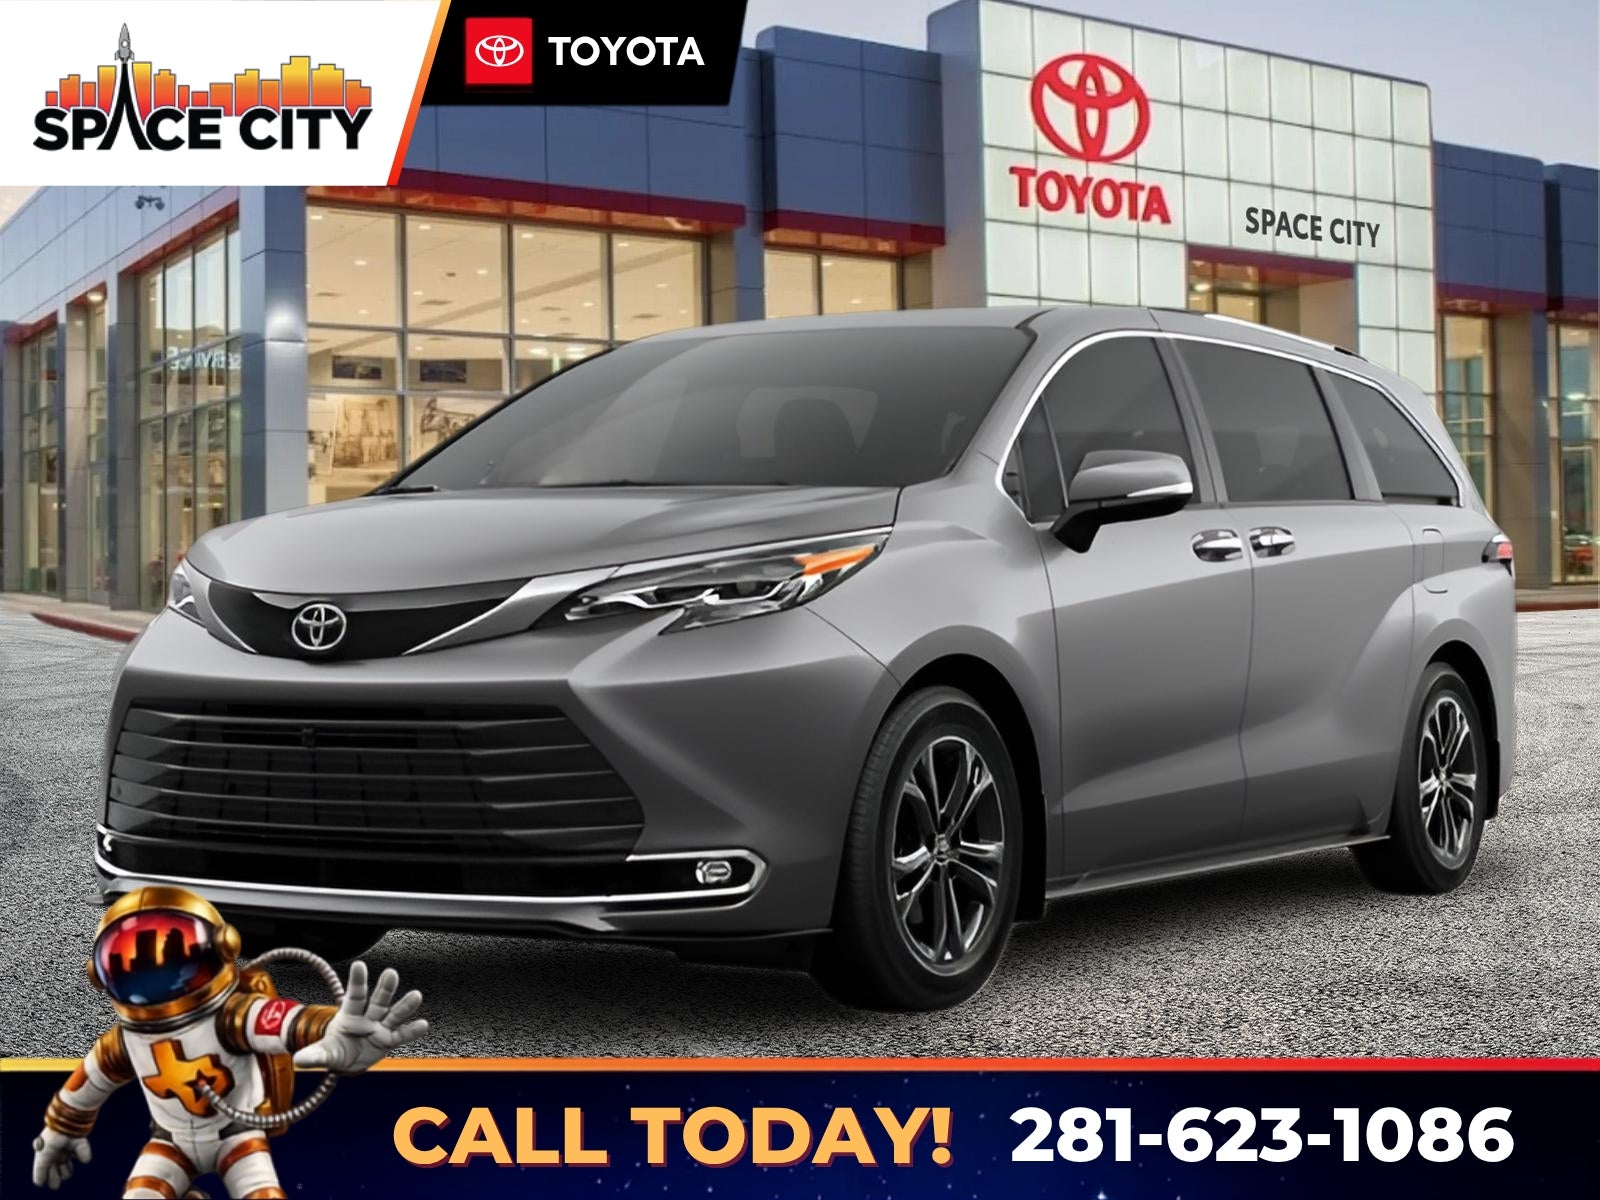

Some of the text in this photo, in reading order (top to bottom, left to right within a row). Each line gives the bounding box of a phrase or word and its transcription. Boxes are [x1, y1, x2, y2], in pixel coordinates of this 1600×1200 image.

[1009, 165, 1171, 224] TOYOTA
[1245, 206, 1381, 249] SPACE CITY
